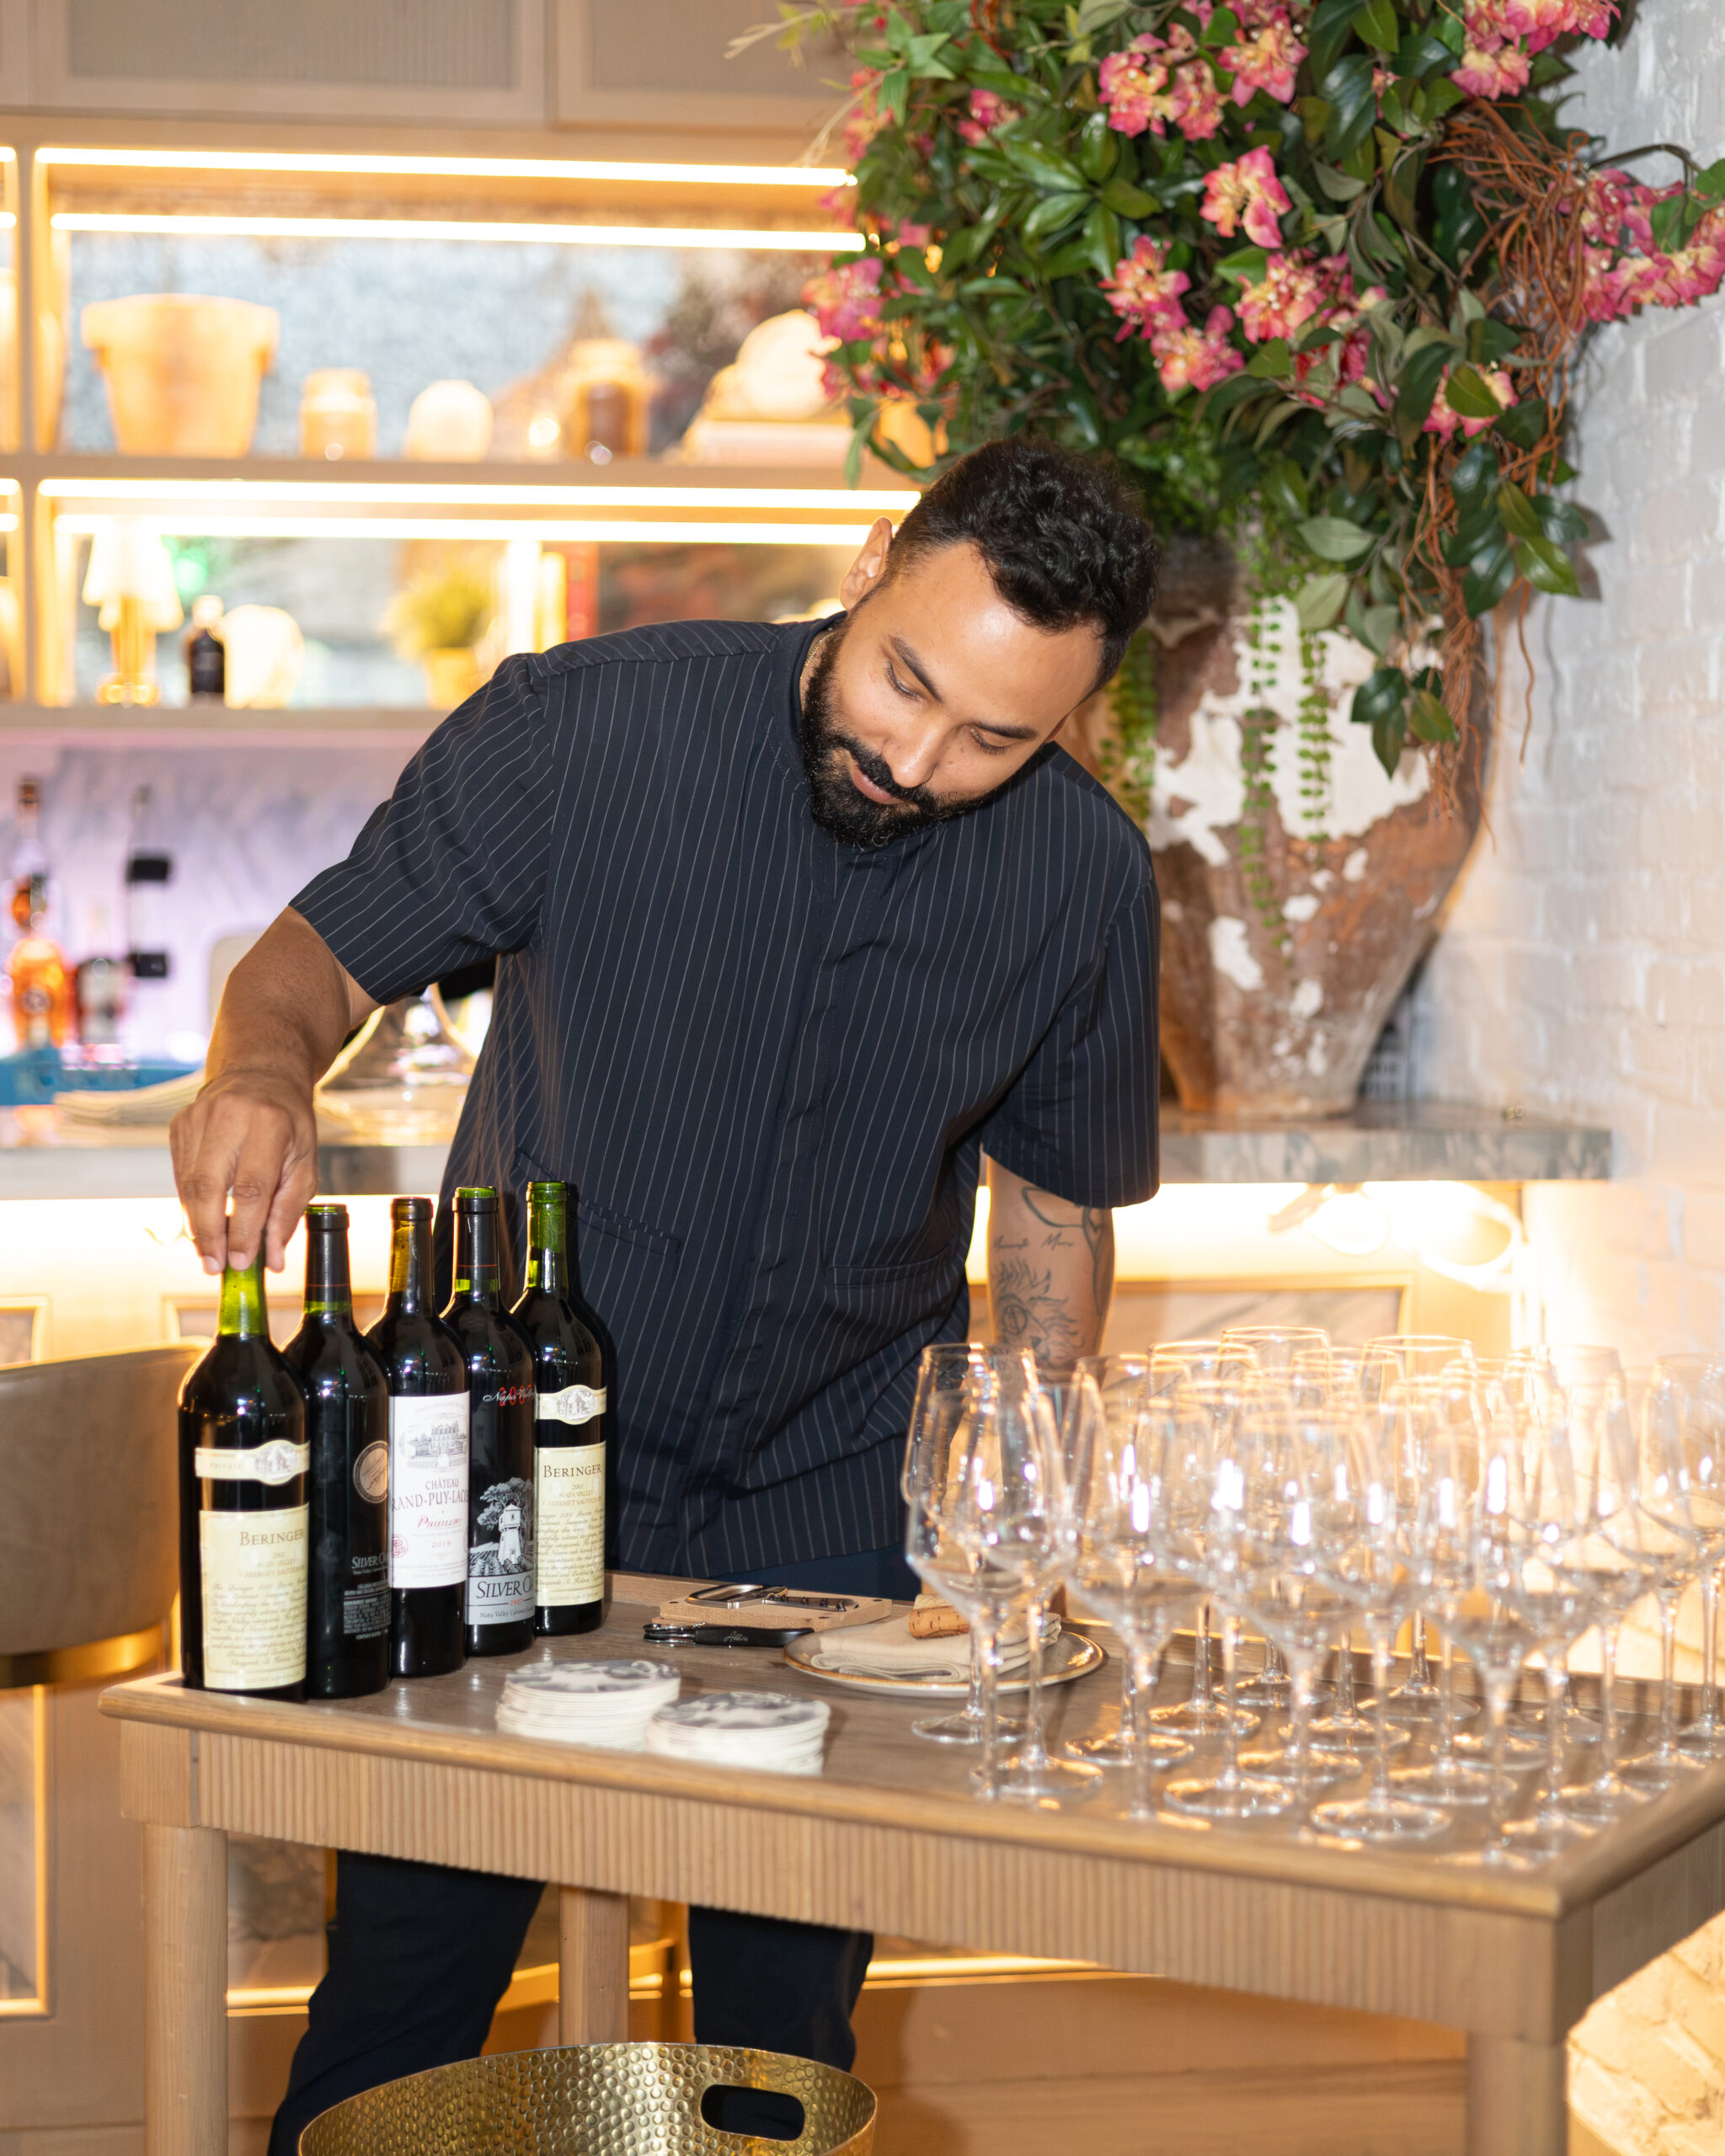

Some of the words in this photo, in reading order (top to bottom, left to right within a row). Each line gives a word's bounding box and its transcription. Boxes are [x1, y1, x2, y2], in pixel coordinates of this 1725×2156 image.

[543, 1464, 602, 1478] BERINGER
[240, 1529, 303, 1545] BERINGER
[352, 1556, 378, 1569] SILVER
[475, 1581, 521, 1598] SILVER
[510, 1598, 524, 1606] 2007
[494, 1609, 510, 1618] Valley
